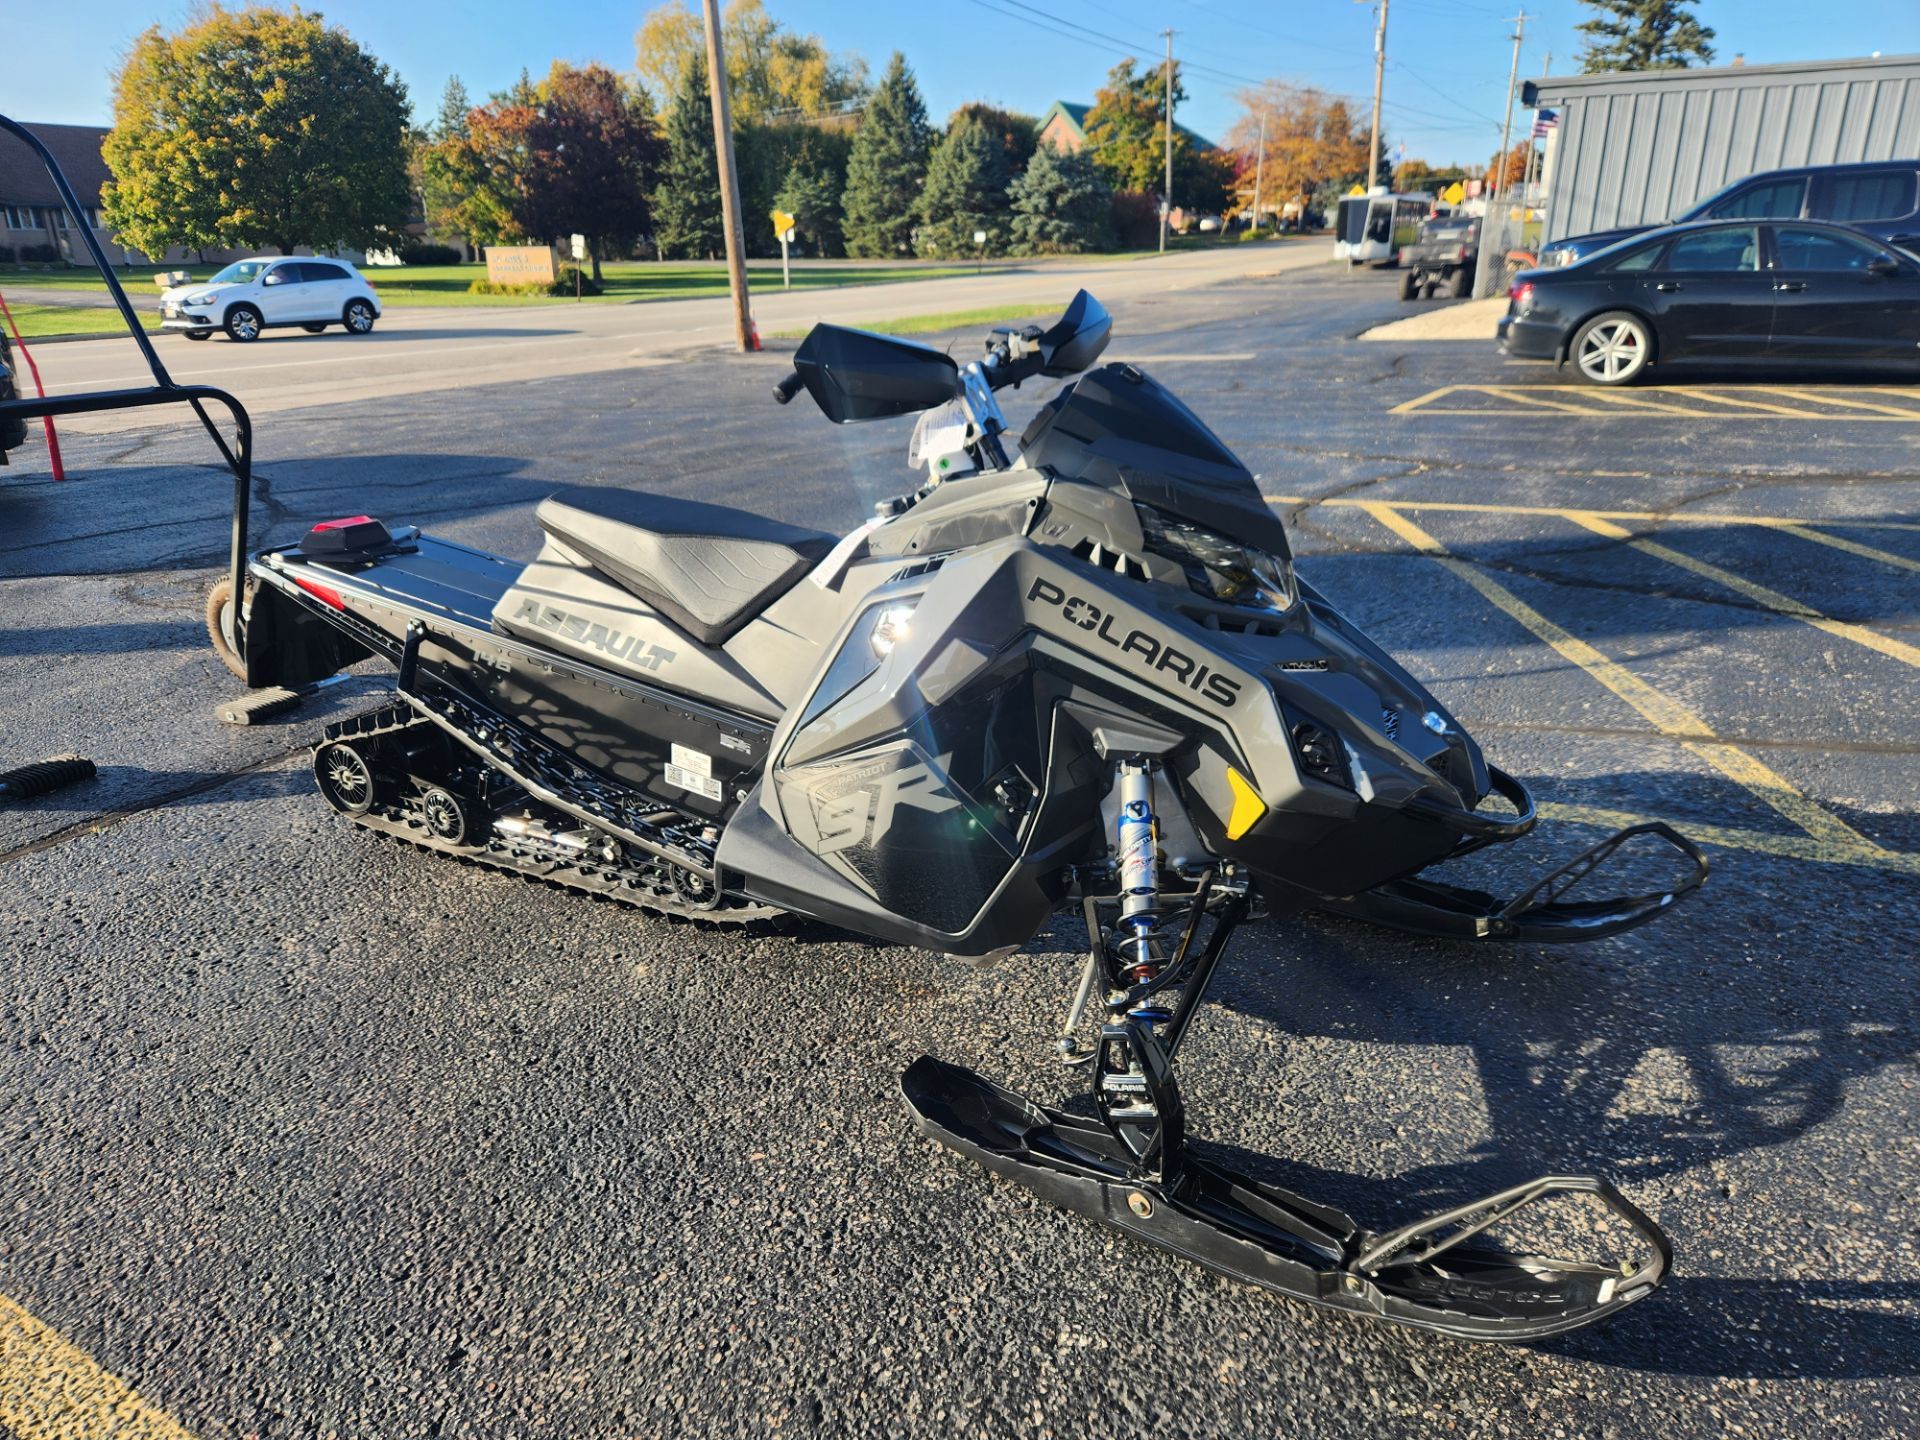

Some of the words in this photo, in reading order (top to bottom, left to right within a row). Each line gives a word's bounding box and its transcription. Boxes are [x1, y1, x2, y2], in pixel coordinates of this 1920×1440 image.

[513, 598, 678, 671] ASSAULT
[1025, 576, 1242, 708] POLARIS
[473, 650, 512, 673] 146
[838, 762, 888, 787] PATRIOT
[1102, 1082, 1146, 1092] POLARIS
